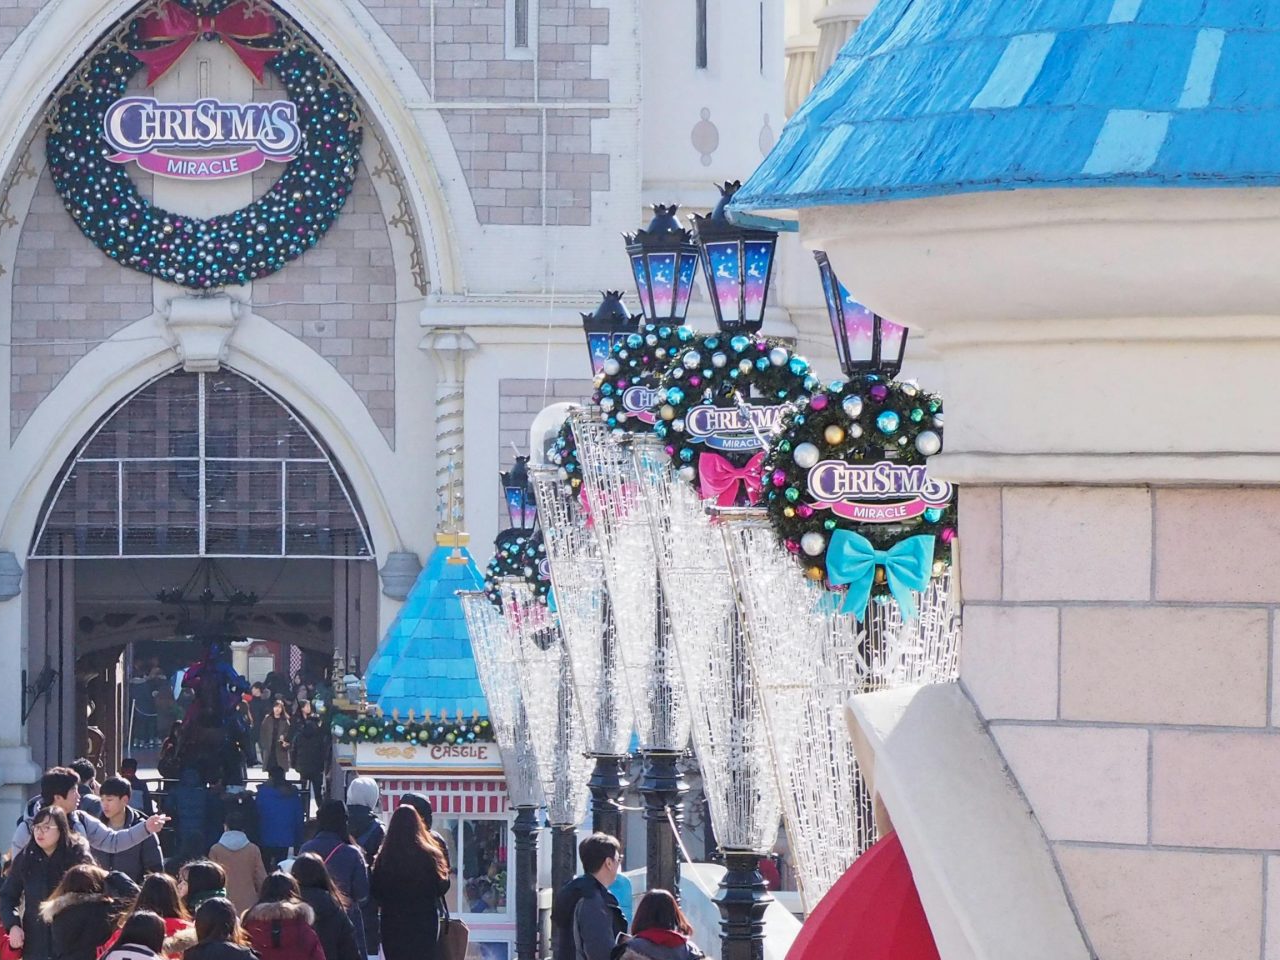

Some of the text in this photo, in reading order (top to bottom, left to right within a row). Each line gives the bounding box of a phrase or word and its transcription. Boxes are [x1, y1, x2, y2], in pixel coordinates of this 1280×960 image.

[109, 101, 295, 149] CHRISTMAS
[166, 158, 239, 175] MIRACLE
[688, 405, 788, 435] CHRITMA
[853, 505, 907, 518] MIRACLE
[430, 744, 488, 760] CASTLE
